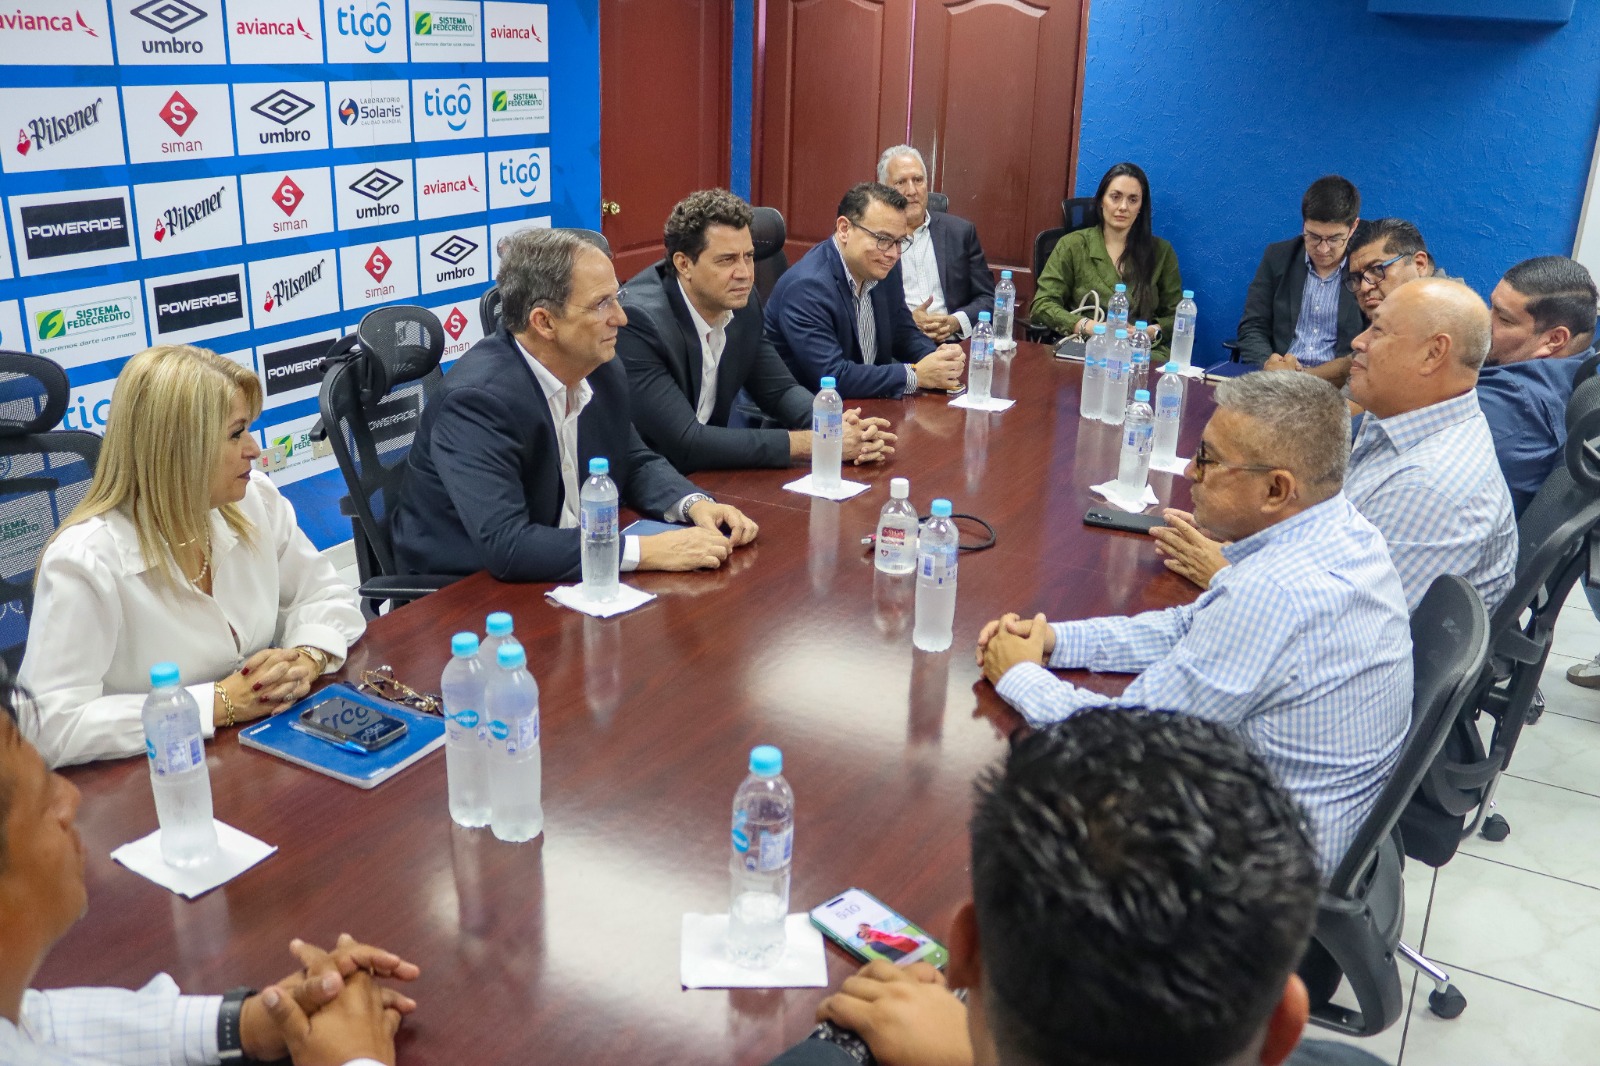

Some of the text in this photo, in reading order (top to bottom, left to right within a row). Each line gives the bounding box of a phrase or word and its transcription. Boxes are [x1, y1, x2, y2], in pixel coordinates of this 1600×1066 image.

[236, 17, 295, 35] avianca
[432, 24, 473, 32] FEDECREDITO
[438, 16, 467, 25] SISTEMA
[490, 24, 530, 39] avianca
[142, 37, 204, 54] umbro
[360, 97, 401, 105] LABORATORIO
[507, 99, 543, 107] FEDECREDITO
[513, 93, 537, 101] SISTEMA
[360, 104, 401, 119] Solaris
[28, 97, 103, 153] Pilsener
[259, 128, 311, 144] umbro
[161, 139, 203, 154] siman
[423, 179, 467, 195] avianca
[163, 185, 227, 237] Pilsener
[356, 203, 400, 219] umbro
[27, 216, 124, 240] POWERADE
[273, 218, 308, 233] siman
[436, 265, 475, 283] umbro
[272, 258, 326, 308] Pilsener
[364, 284, 395, 299] siman
[158, 291, 238, 316] POWERADE
[67, 310, 131, 330] FEDECREDITO
[76, 304, 120, 320] SISTEMA
[39, 343, 78, 355] Queremos
[79, 339, 100, 347] darte
[117, 331, 137, 340] mano
[443, 341, 470, 356] siman
